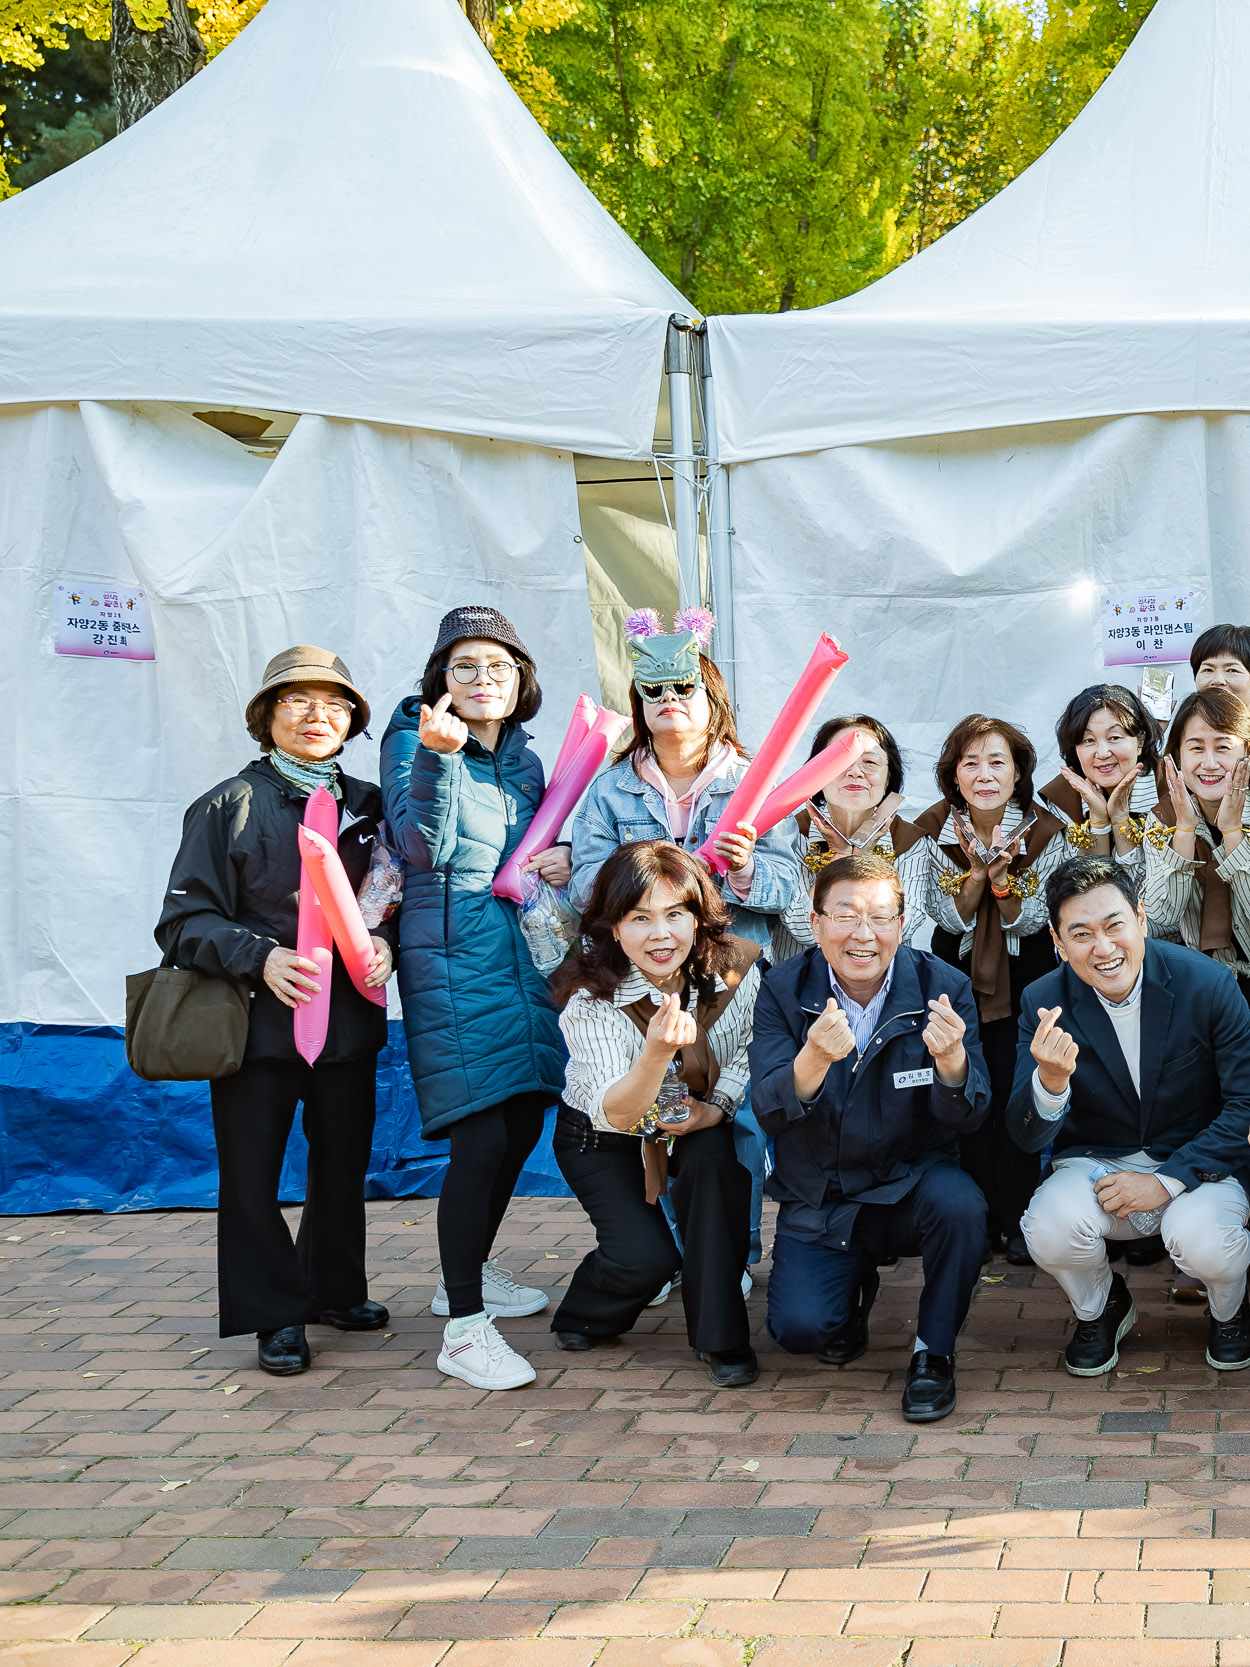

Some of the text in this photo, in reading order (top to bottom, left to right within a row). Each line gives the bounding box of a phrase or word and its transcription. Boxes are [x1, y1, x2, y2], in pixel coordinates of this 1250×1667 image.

[67, 617, 109, 632] 자양2동
[1108, 622, 1193, 639] 자양3동 라인댄스팀
